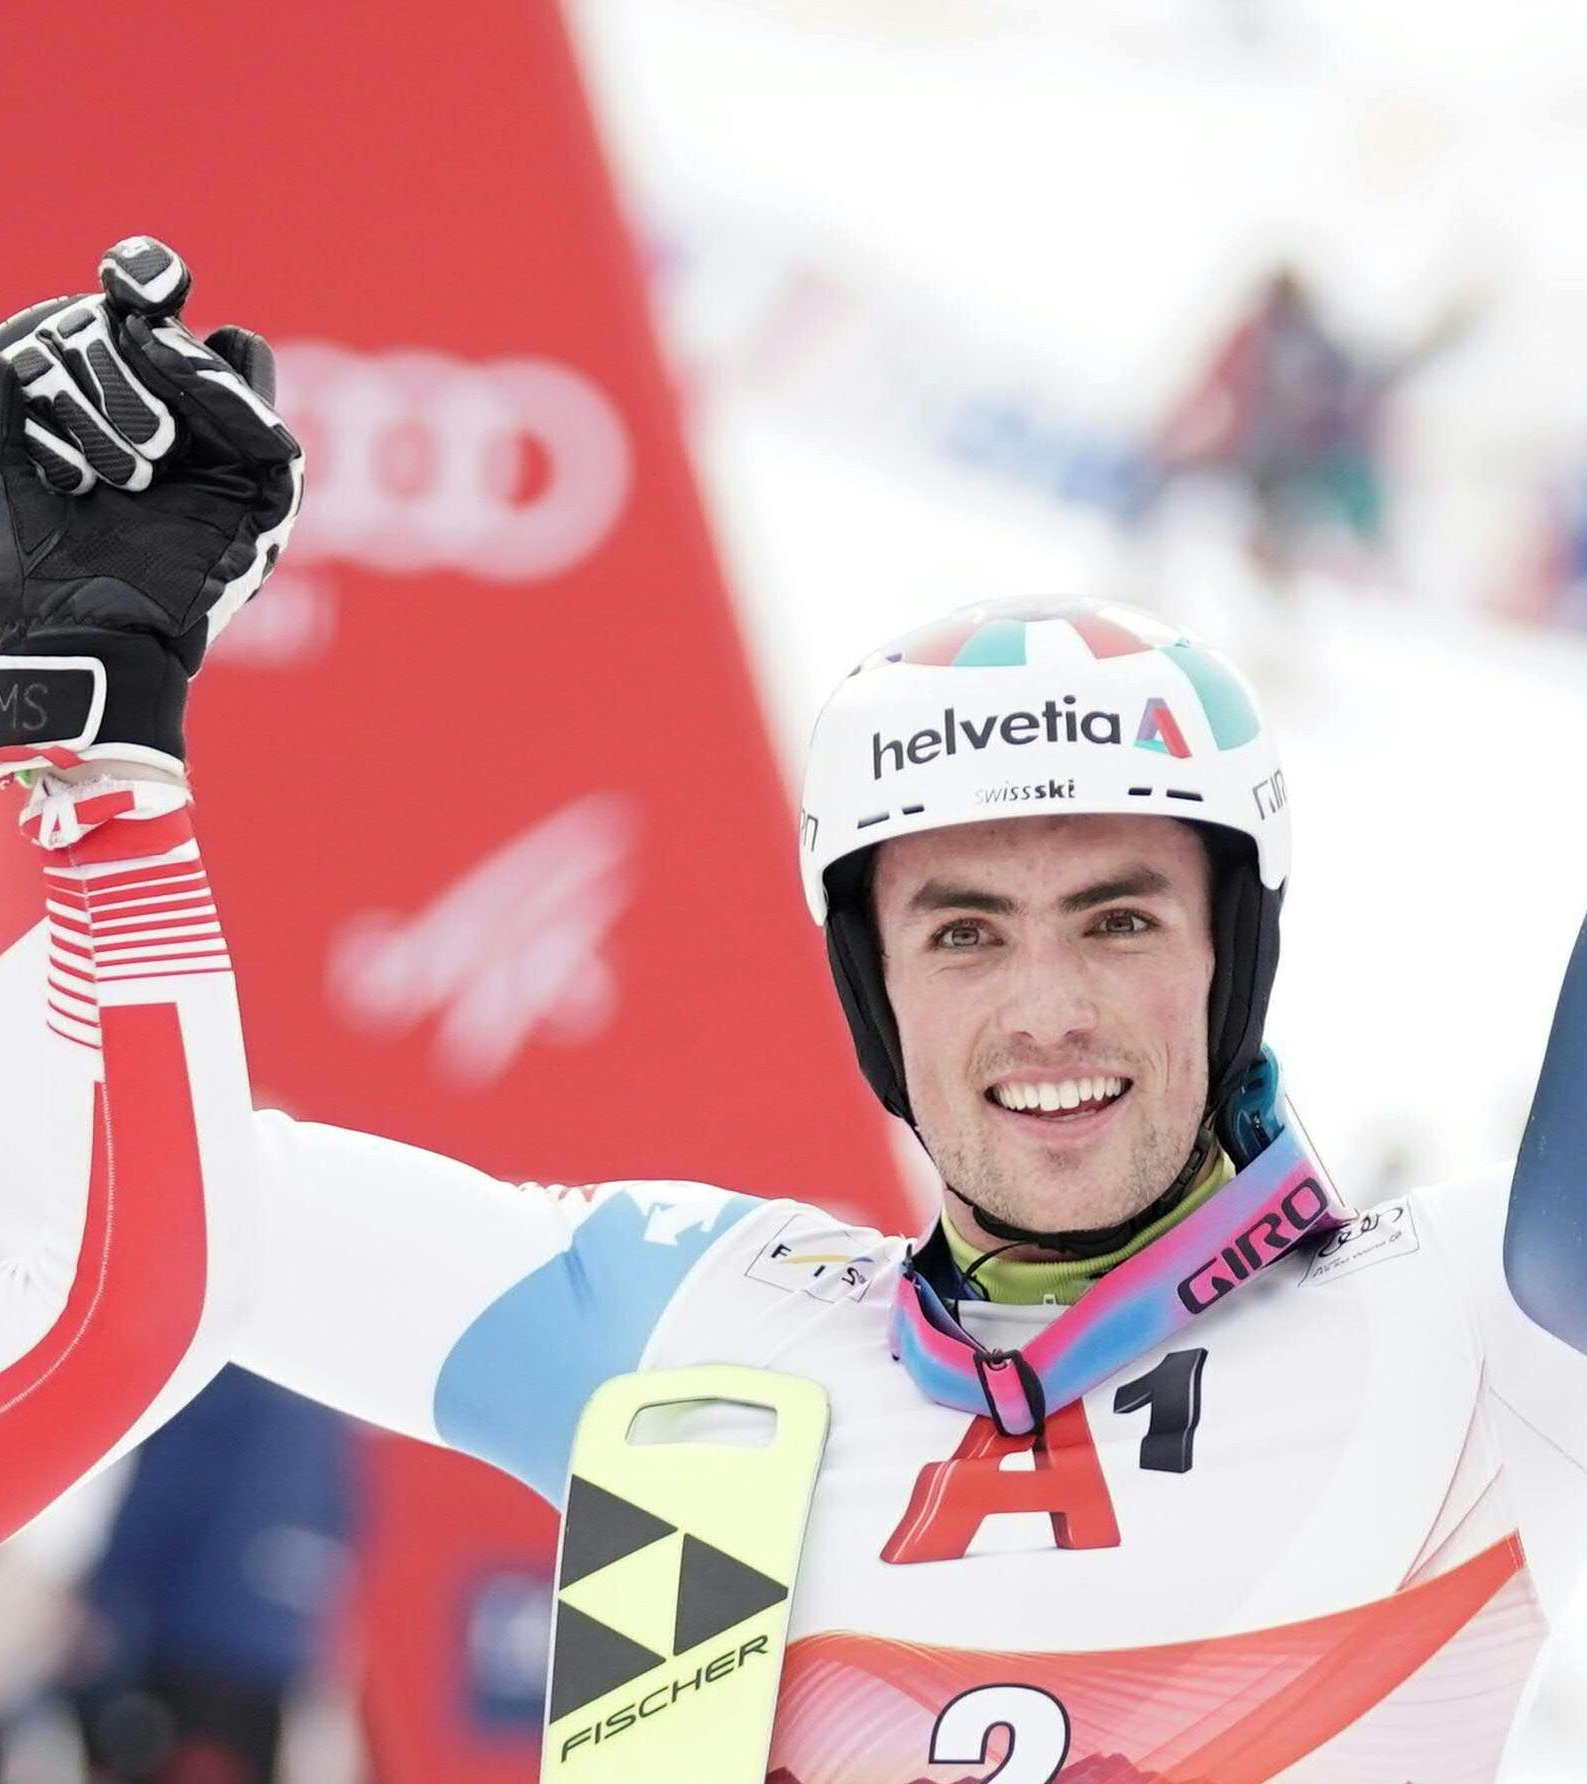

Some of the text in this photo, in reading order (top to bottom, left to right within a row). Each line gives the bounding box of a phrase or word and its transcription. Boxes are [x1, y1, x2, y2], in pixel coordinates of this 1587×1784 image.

[873, 694, 1122, 781] helvetia
[1177, 1177, 1329, 1315] GIRO
[560, 1634, 769, 1763] FISCHER
